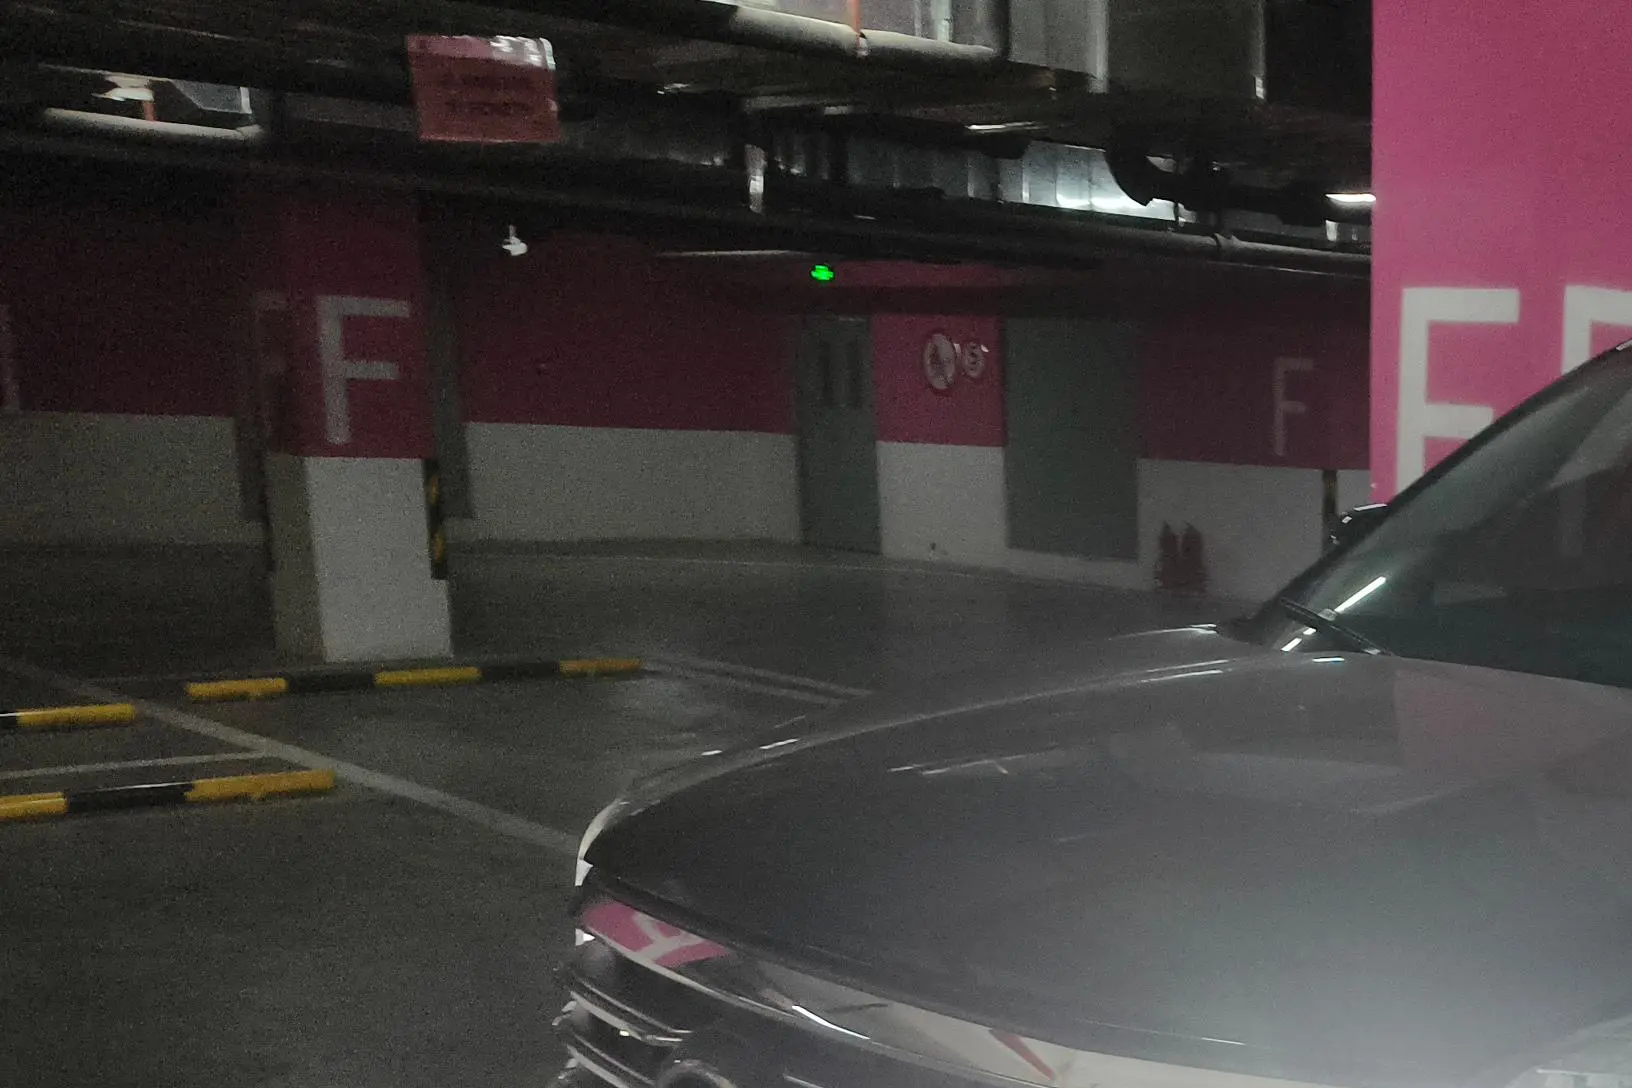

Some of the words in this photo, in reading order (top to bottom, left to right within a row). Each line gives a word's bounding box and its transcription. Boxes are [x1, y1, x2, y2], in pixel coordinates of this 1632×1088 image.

[316, 295, 410, 445] F
[1273, 357, 1315, 456] F
[1396, 286, 1520, 496] F
